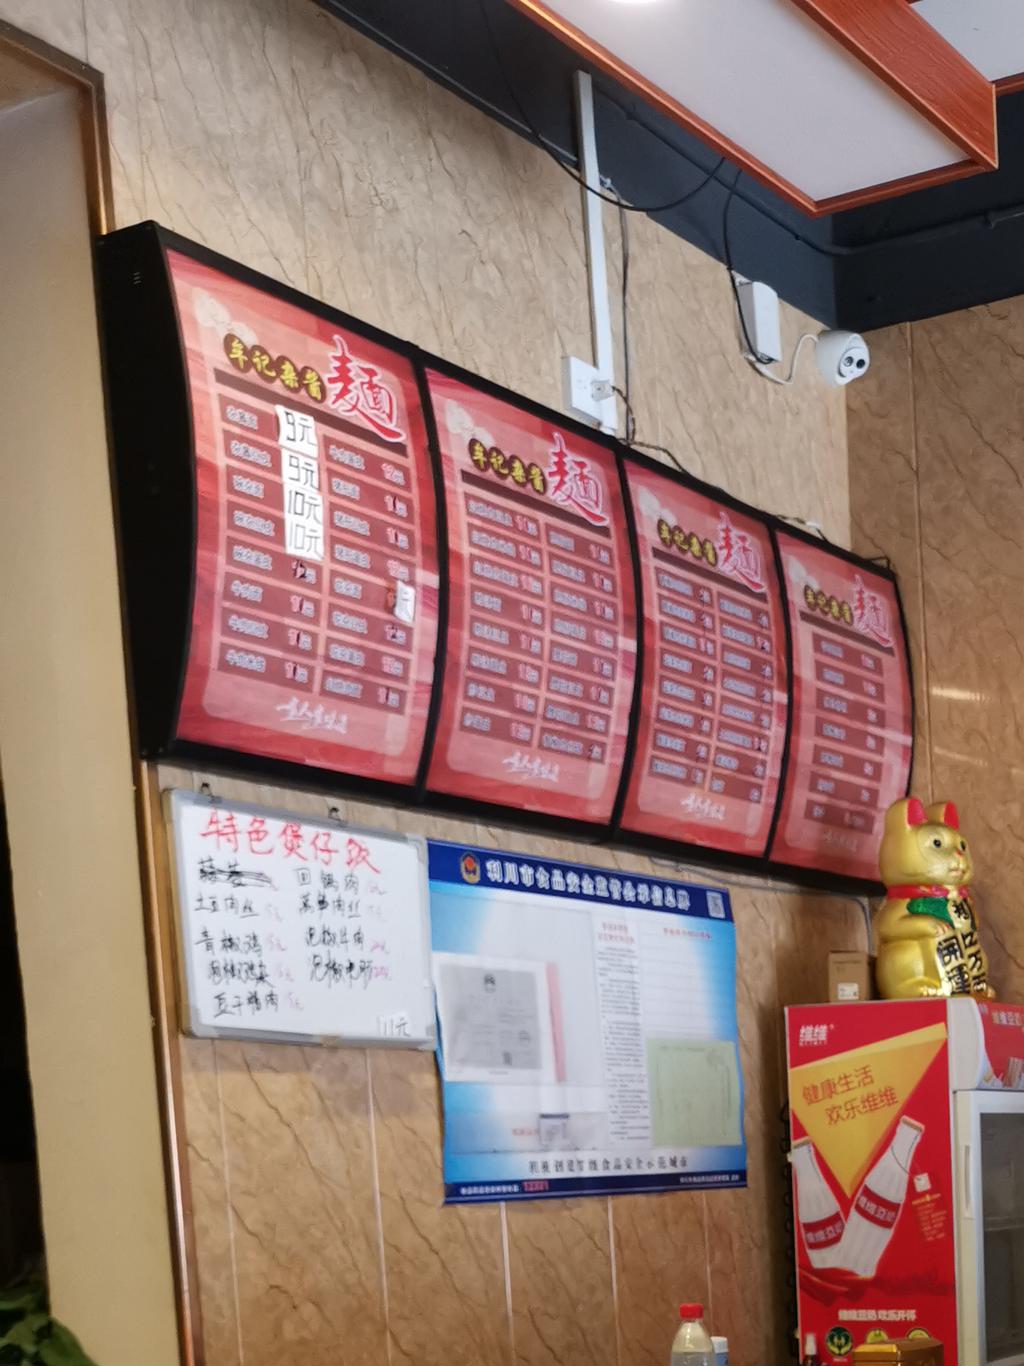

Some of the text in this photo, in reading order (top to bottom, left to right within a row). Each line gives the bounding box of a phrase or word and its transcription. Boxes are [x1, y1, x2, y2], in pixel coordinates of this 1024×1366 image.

[803, 1065, 875, 1106] 健康生活
[825, 1086, 899, 1125] 欢乐维维
